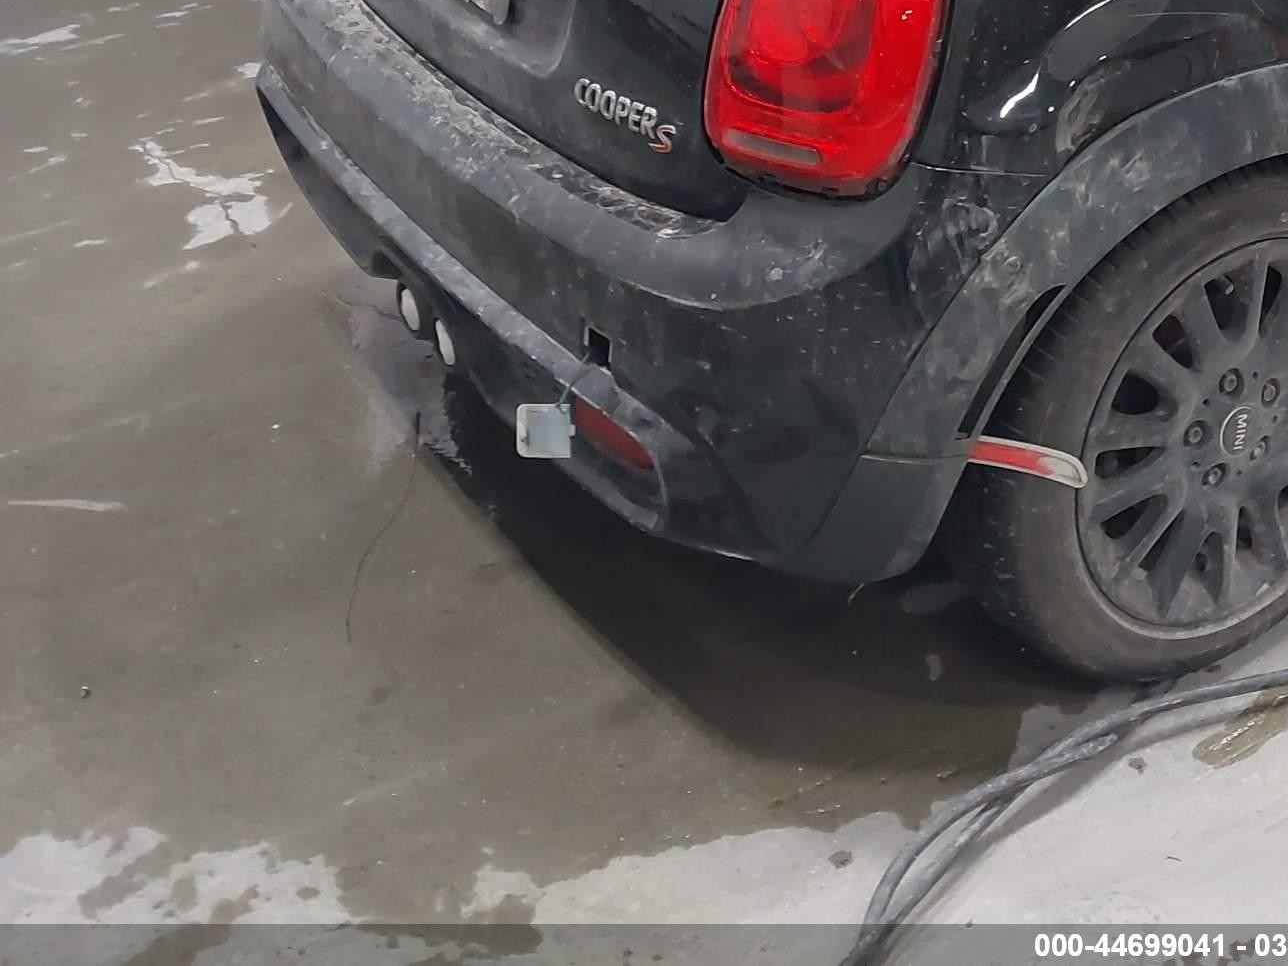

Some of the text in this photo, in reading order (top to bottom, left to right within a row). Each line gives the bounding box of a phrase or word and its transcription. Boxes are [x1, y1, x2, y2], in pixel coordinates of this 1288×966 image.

[574, 77, 677, 153] COOPER S
[1233, 413, 1249, 450] MINI
